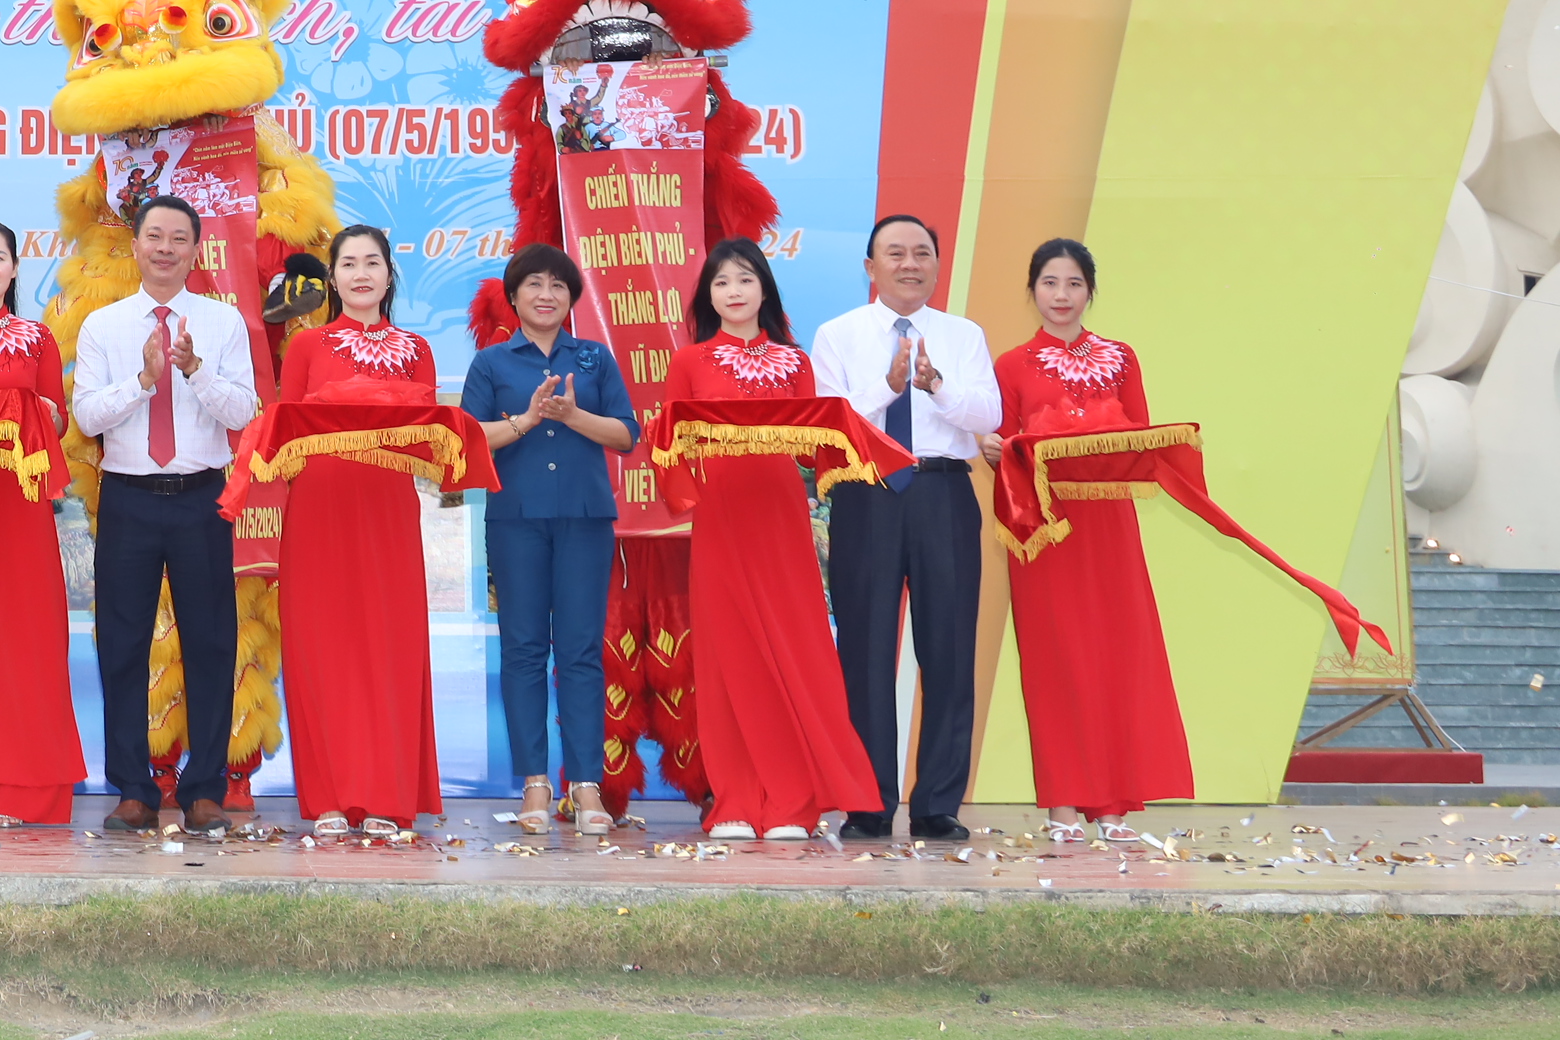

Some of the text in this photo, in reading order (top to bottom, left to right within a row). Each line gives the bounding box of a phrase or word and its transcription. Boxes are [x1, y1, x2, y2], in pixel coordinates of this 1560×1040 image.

[327, 106, 517, 160] (07/5/195
[585, 161, 682, 210] CHIẾN THẮNG
[424, 229, 469, 258] 07
[579, 228, 619, 275] ĐIỆN
[619, 225, 654, 266] BIÊN
[655, 221, 686, 266] PHỦ
[608, 278, 685, 330] THẮNG LỢI
[630, 343, 648, 384] VĨ
